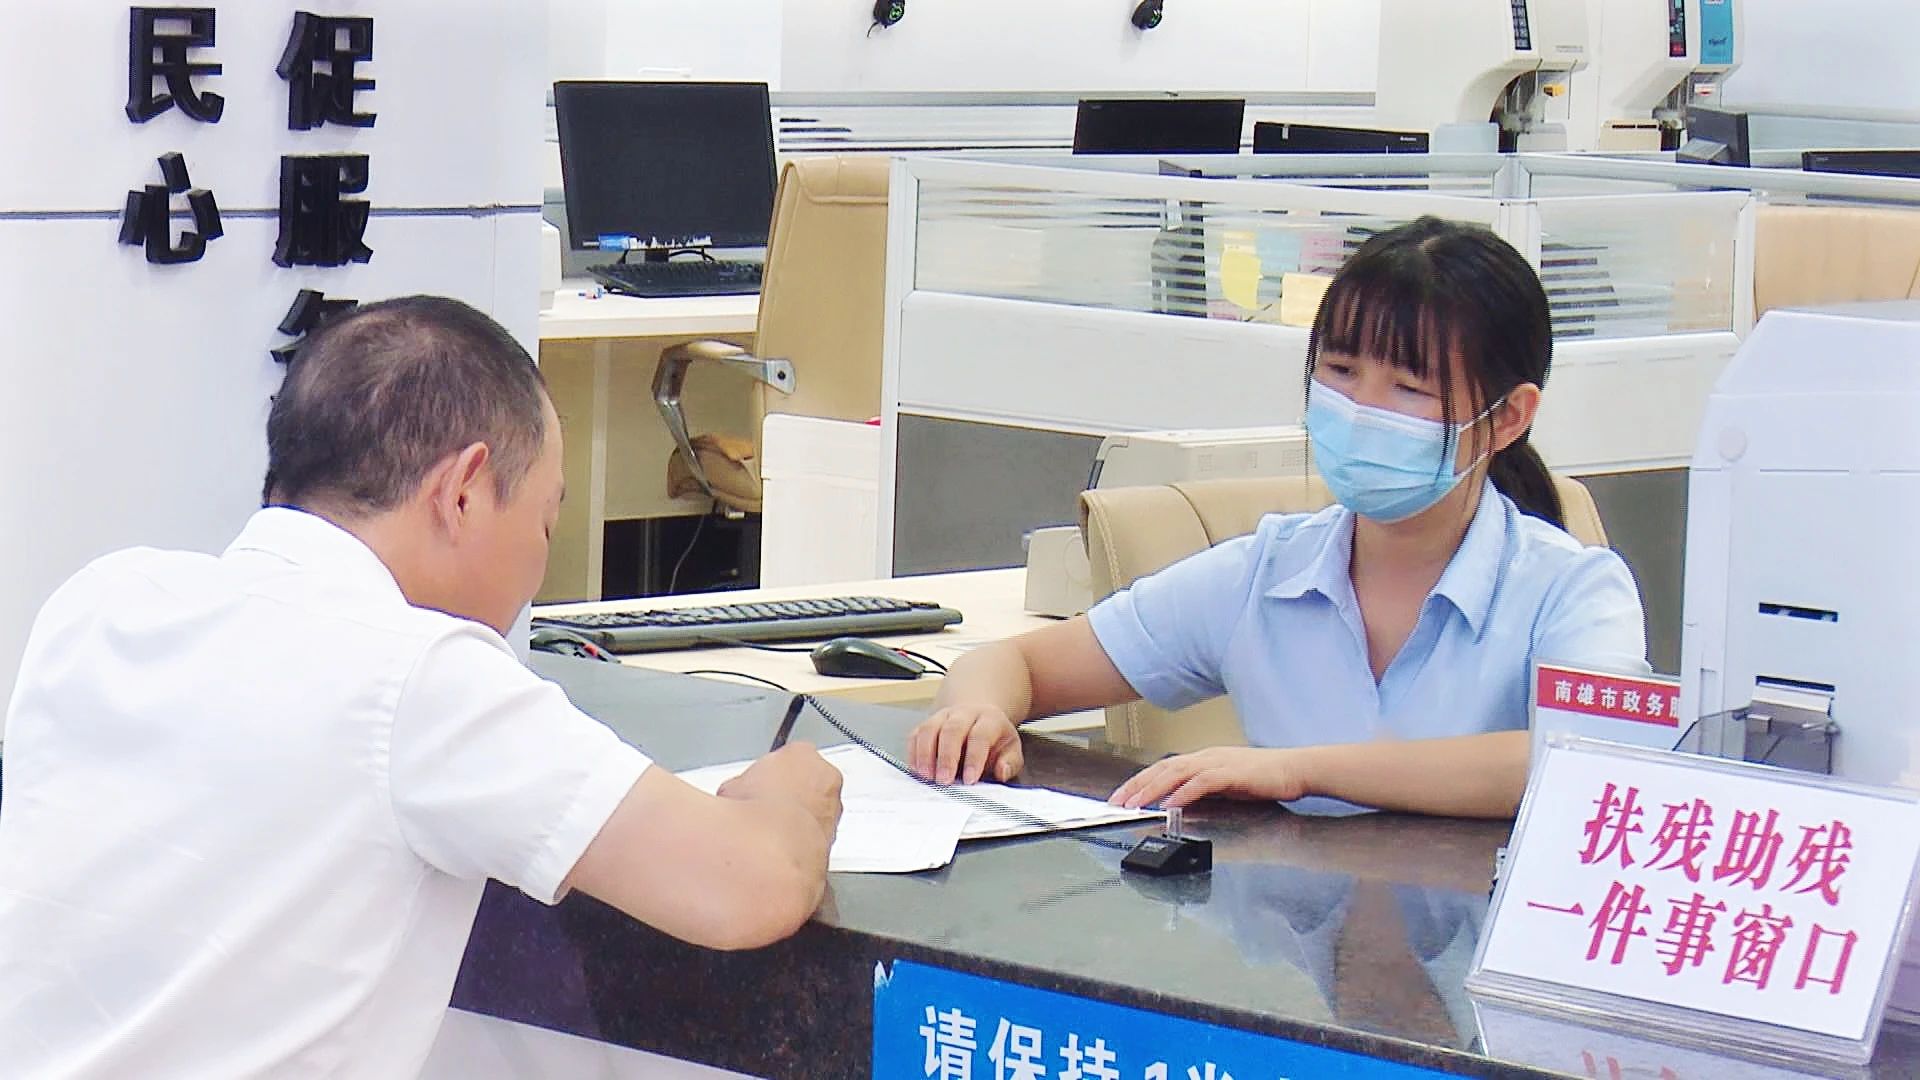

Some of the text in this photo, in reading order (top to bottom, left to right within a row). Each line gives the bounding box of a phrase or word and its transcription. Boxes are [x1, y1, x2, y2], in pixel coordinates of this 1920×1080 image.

[119, 7, 225, 264] 民心
[1578, 782, 1853, 907] 扶残助残
[1527, 880, 1859, 995] 一件事窗口
